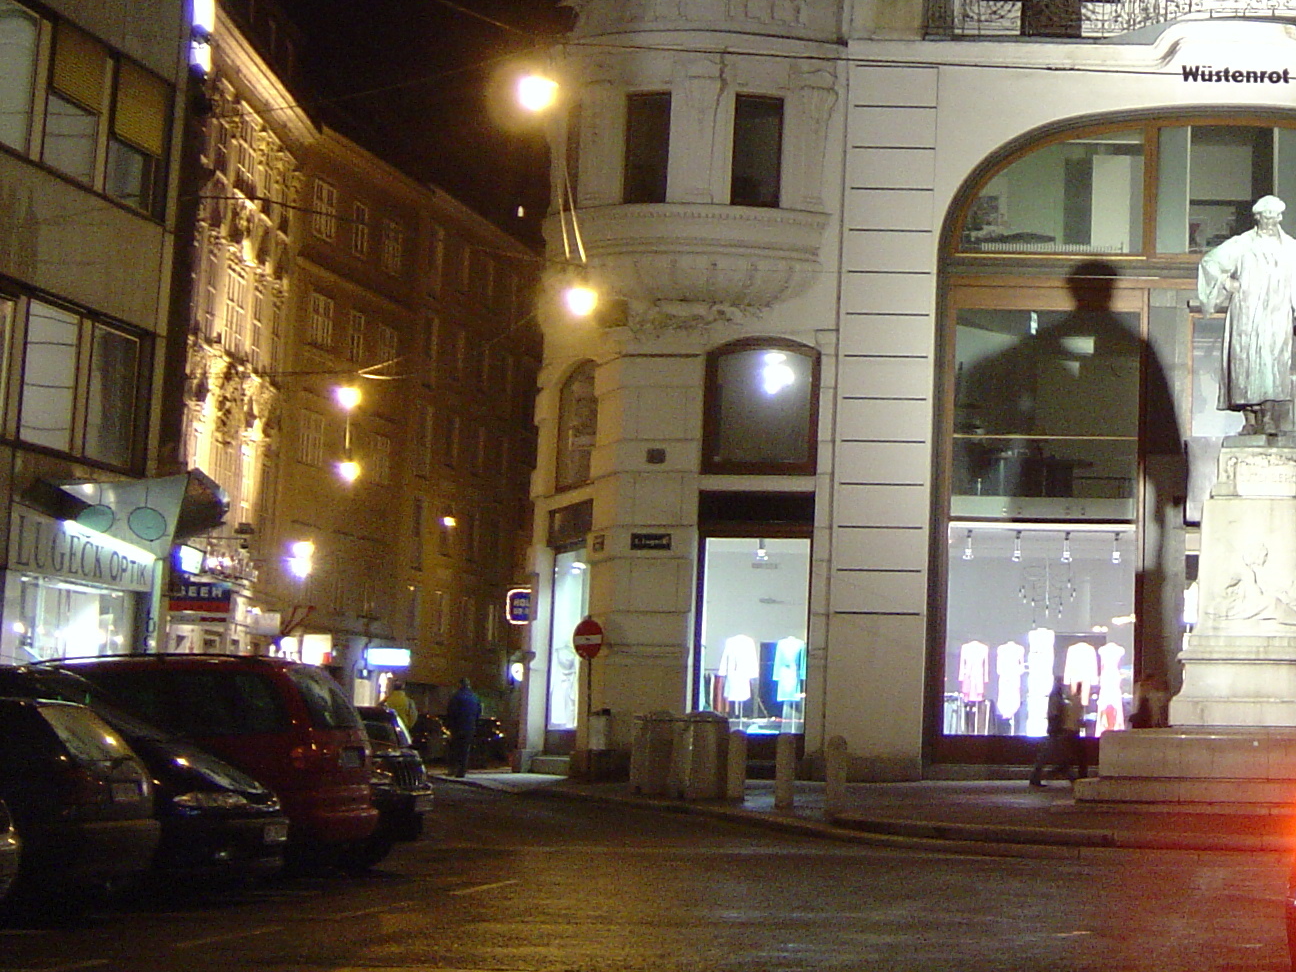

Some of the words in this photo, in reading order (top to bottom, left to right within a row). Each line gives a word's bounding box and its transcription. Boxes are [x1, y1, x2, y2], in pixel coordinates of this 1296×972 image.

[1182, 64, 1290, 84] Wüstenrot
[15, 515, 104, 579] LUGECK
[110, 551, 148, 586] OPTIK
